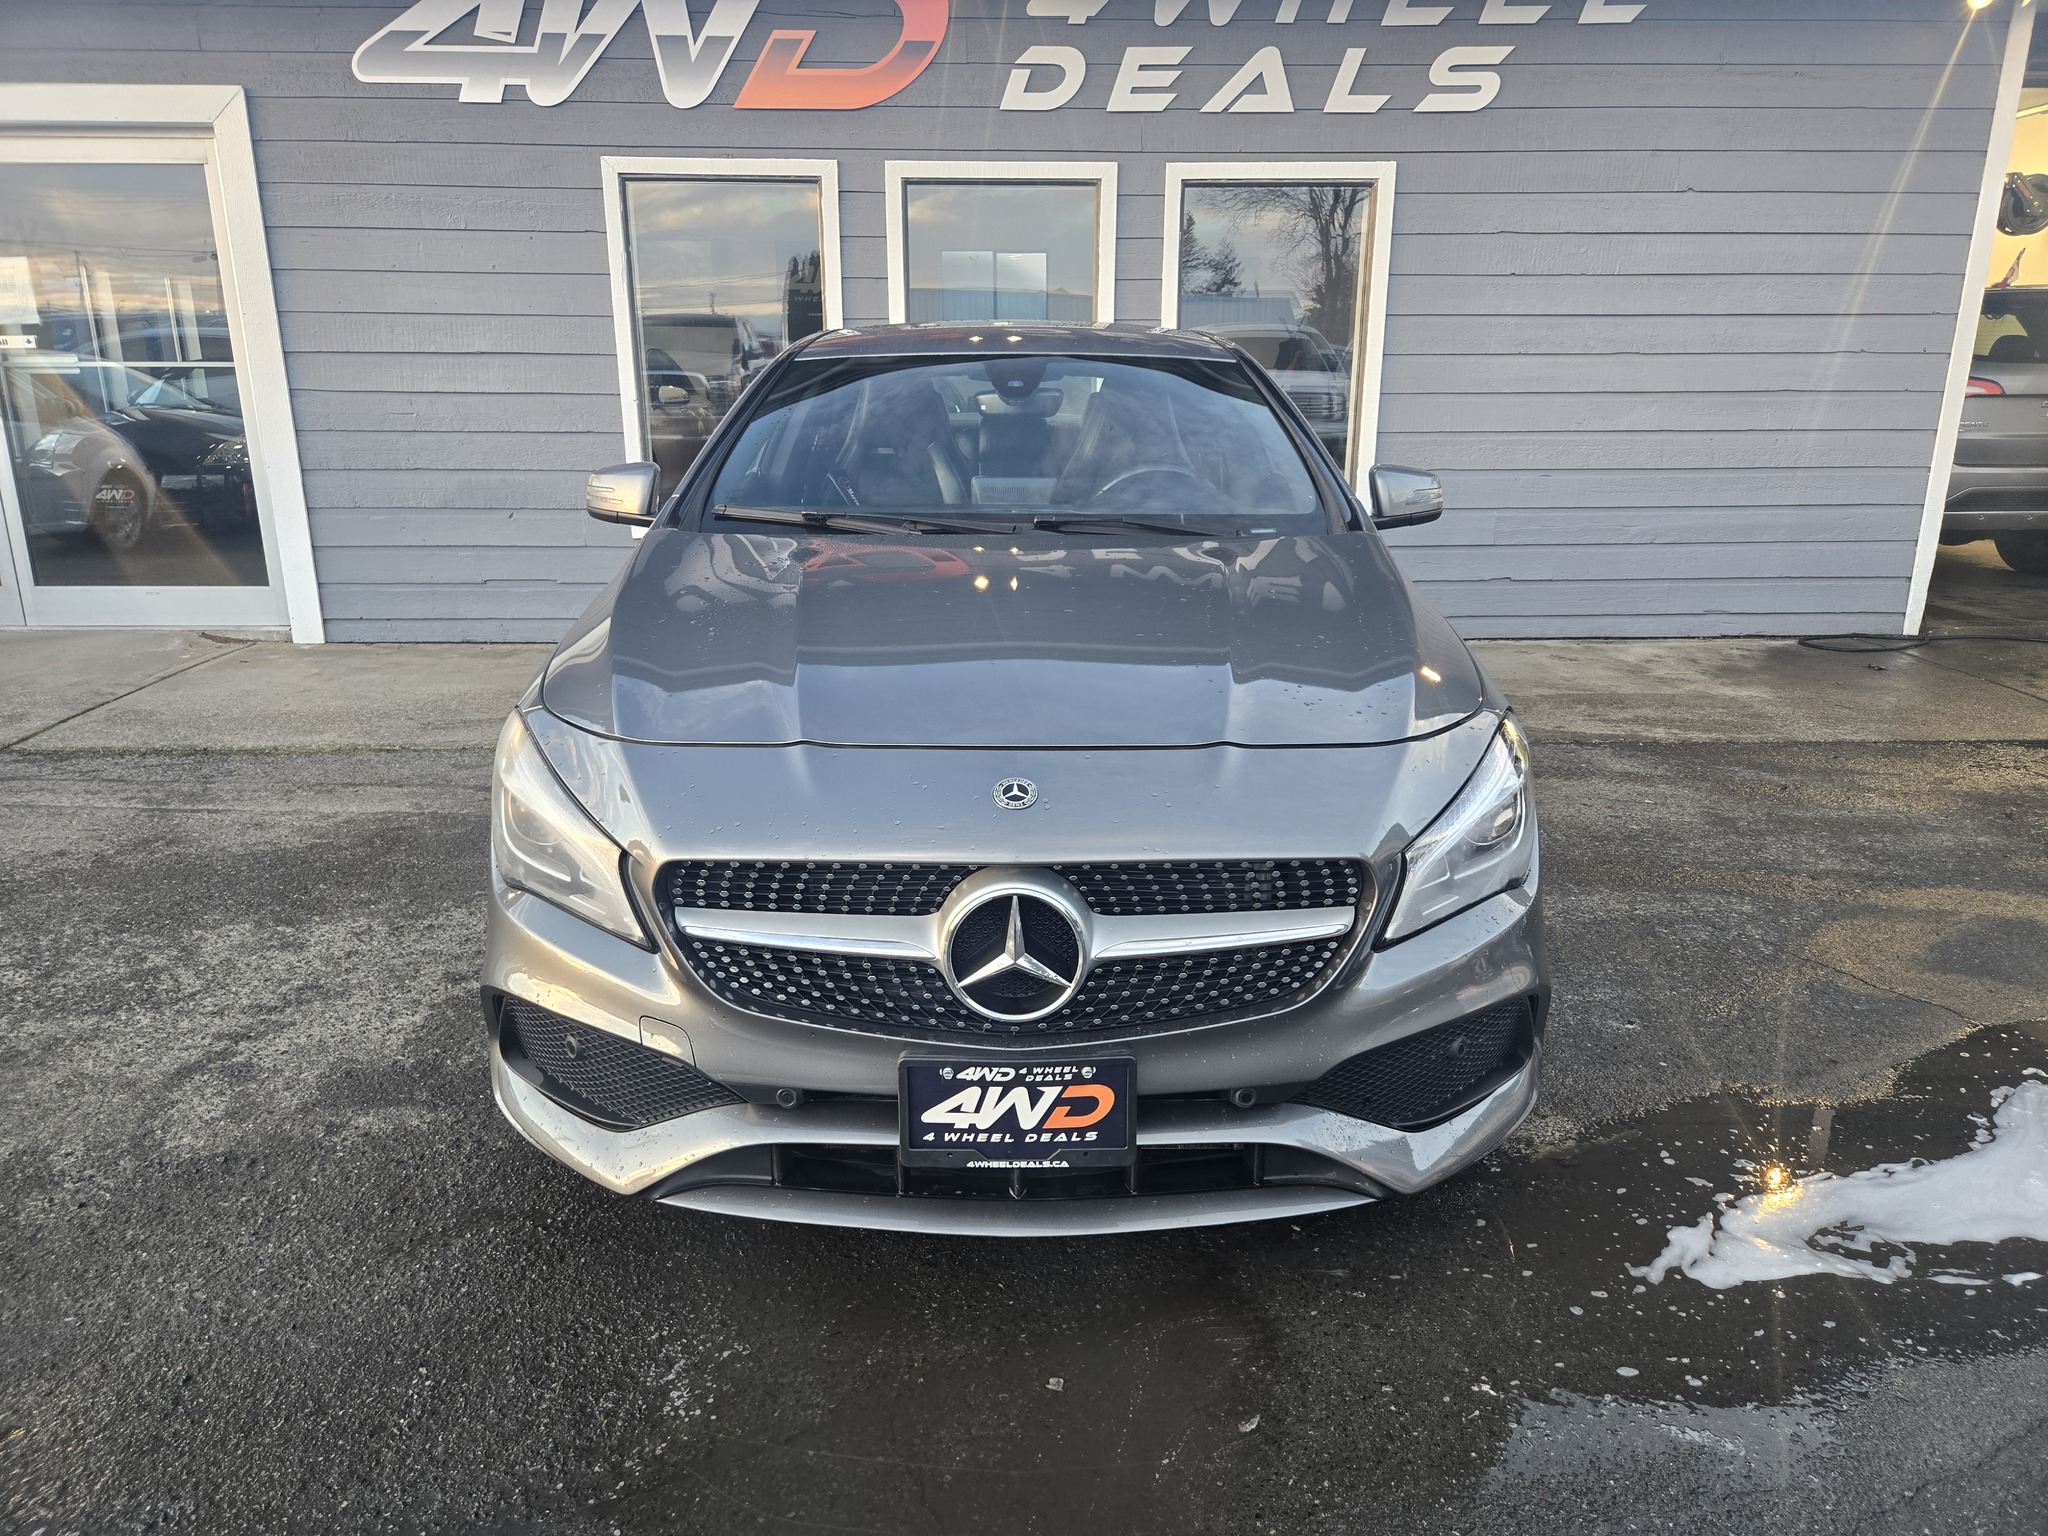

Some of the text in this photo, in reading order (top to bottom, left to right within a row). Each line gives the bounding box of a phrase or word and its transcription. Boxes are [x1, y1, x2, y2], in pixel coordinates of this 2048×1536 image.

[352, 0, 949, 110] 4WD
[999, 45, 1516, 113] DEALS
[95, 489, 136, 501] 4WD
[956, 1066, 1016, 1082] 4WD
[1019, 1066, 1078, 1075] 4 WHEEL
[1025, 1074, 1074, 1082] DEALS
[920, 1084, 1115, 1130] 4WD
[923, 1131, 1099, 1143] 4 WHEEL DEALS
[966, 1160, 1070, 1169] 4WHEELDEALS.CA
